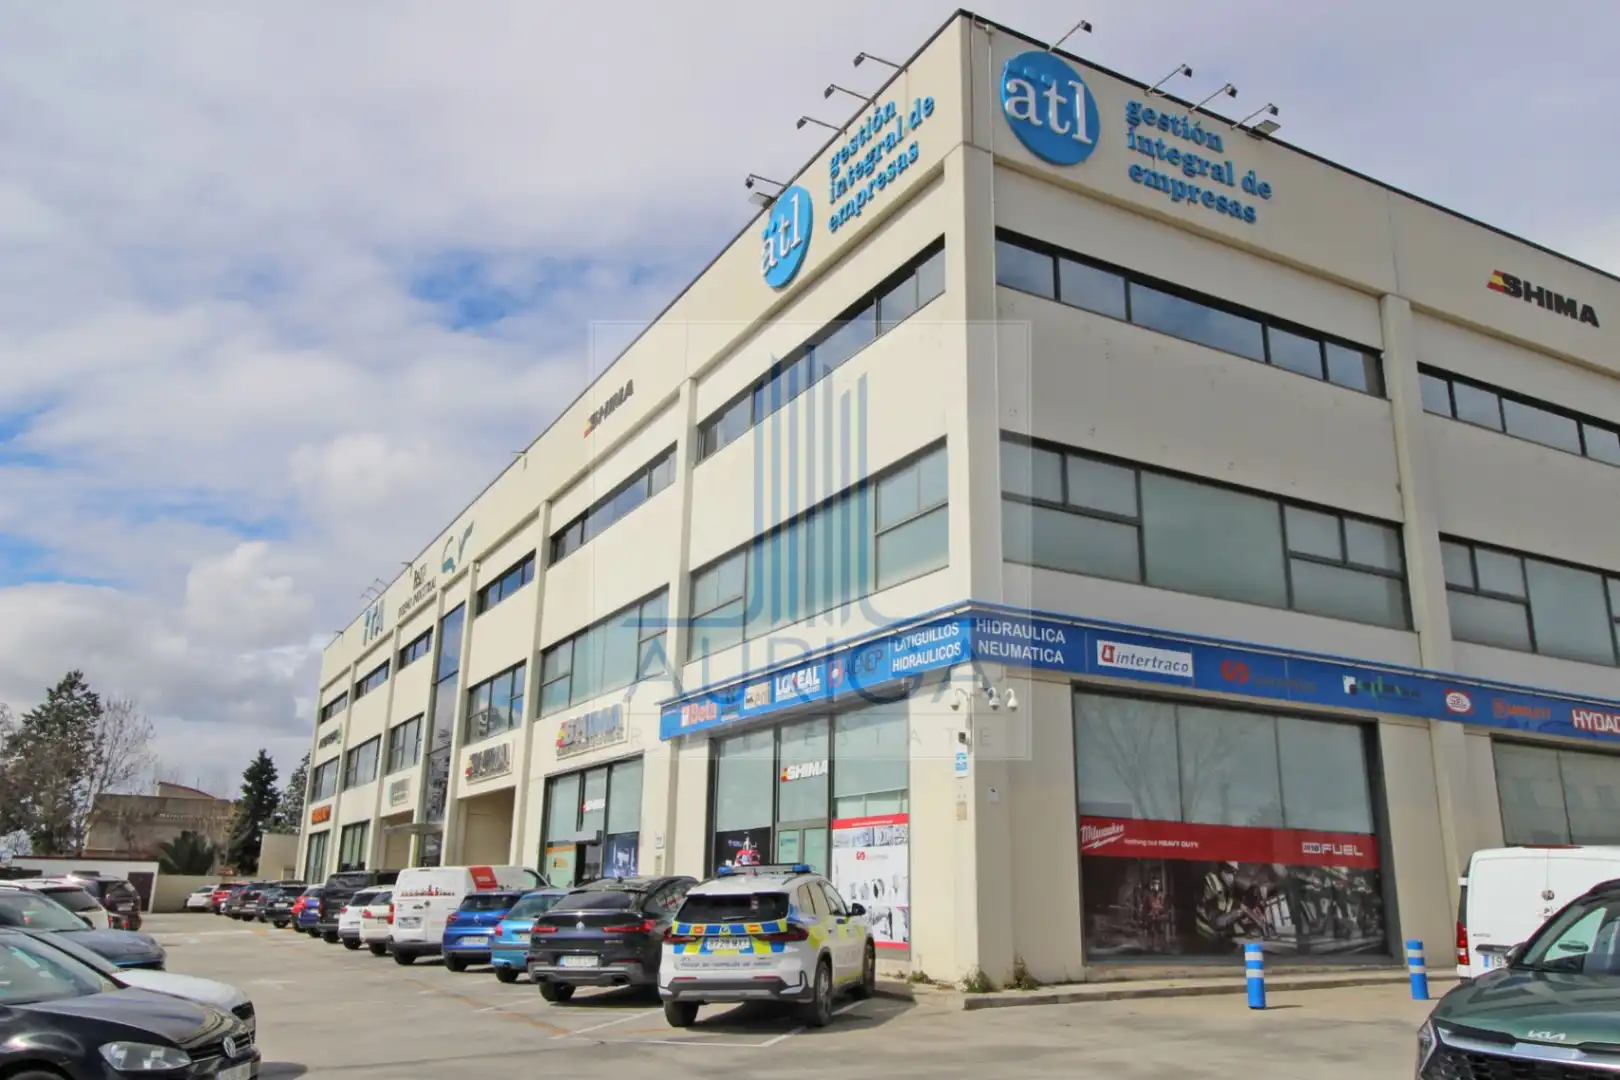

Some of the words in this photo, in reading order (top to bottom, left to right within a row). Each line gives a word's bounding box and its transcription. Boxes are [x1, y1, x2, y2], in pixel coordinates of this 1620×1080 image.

[1004, 78, 1092, 144] atl
[1126, 100, 1224, 153] gestión
[829, 115, 904, 205] integral
[908, 96, 935, 130] de
[830, 101, 897, 179] gestión
[1127, 126, 1235, 187] integral
[1241, 170, 1272, 200] de
[828, 141, 920, 233] empresas
[1128, 162, 1257, 223] empresas
[761, 193, 802, 275] atl
[1502, 272, 1600, 328] SHIMA
[892, 641, 961, 672] HIDRAULICOS
[894, 622, 960, 652] LATIGUILLOS
[976, 618, 1066, 644] HIDRAULICA
[978, 639, 1065, 665] NEUMATICA
[1115, 651, 1189, 673] intertraco
[787, 760, 828, 780] SHIMA
[1321, 843, 1364, 857] FUEL
